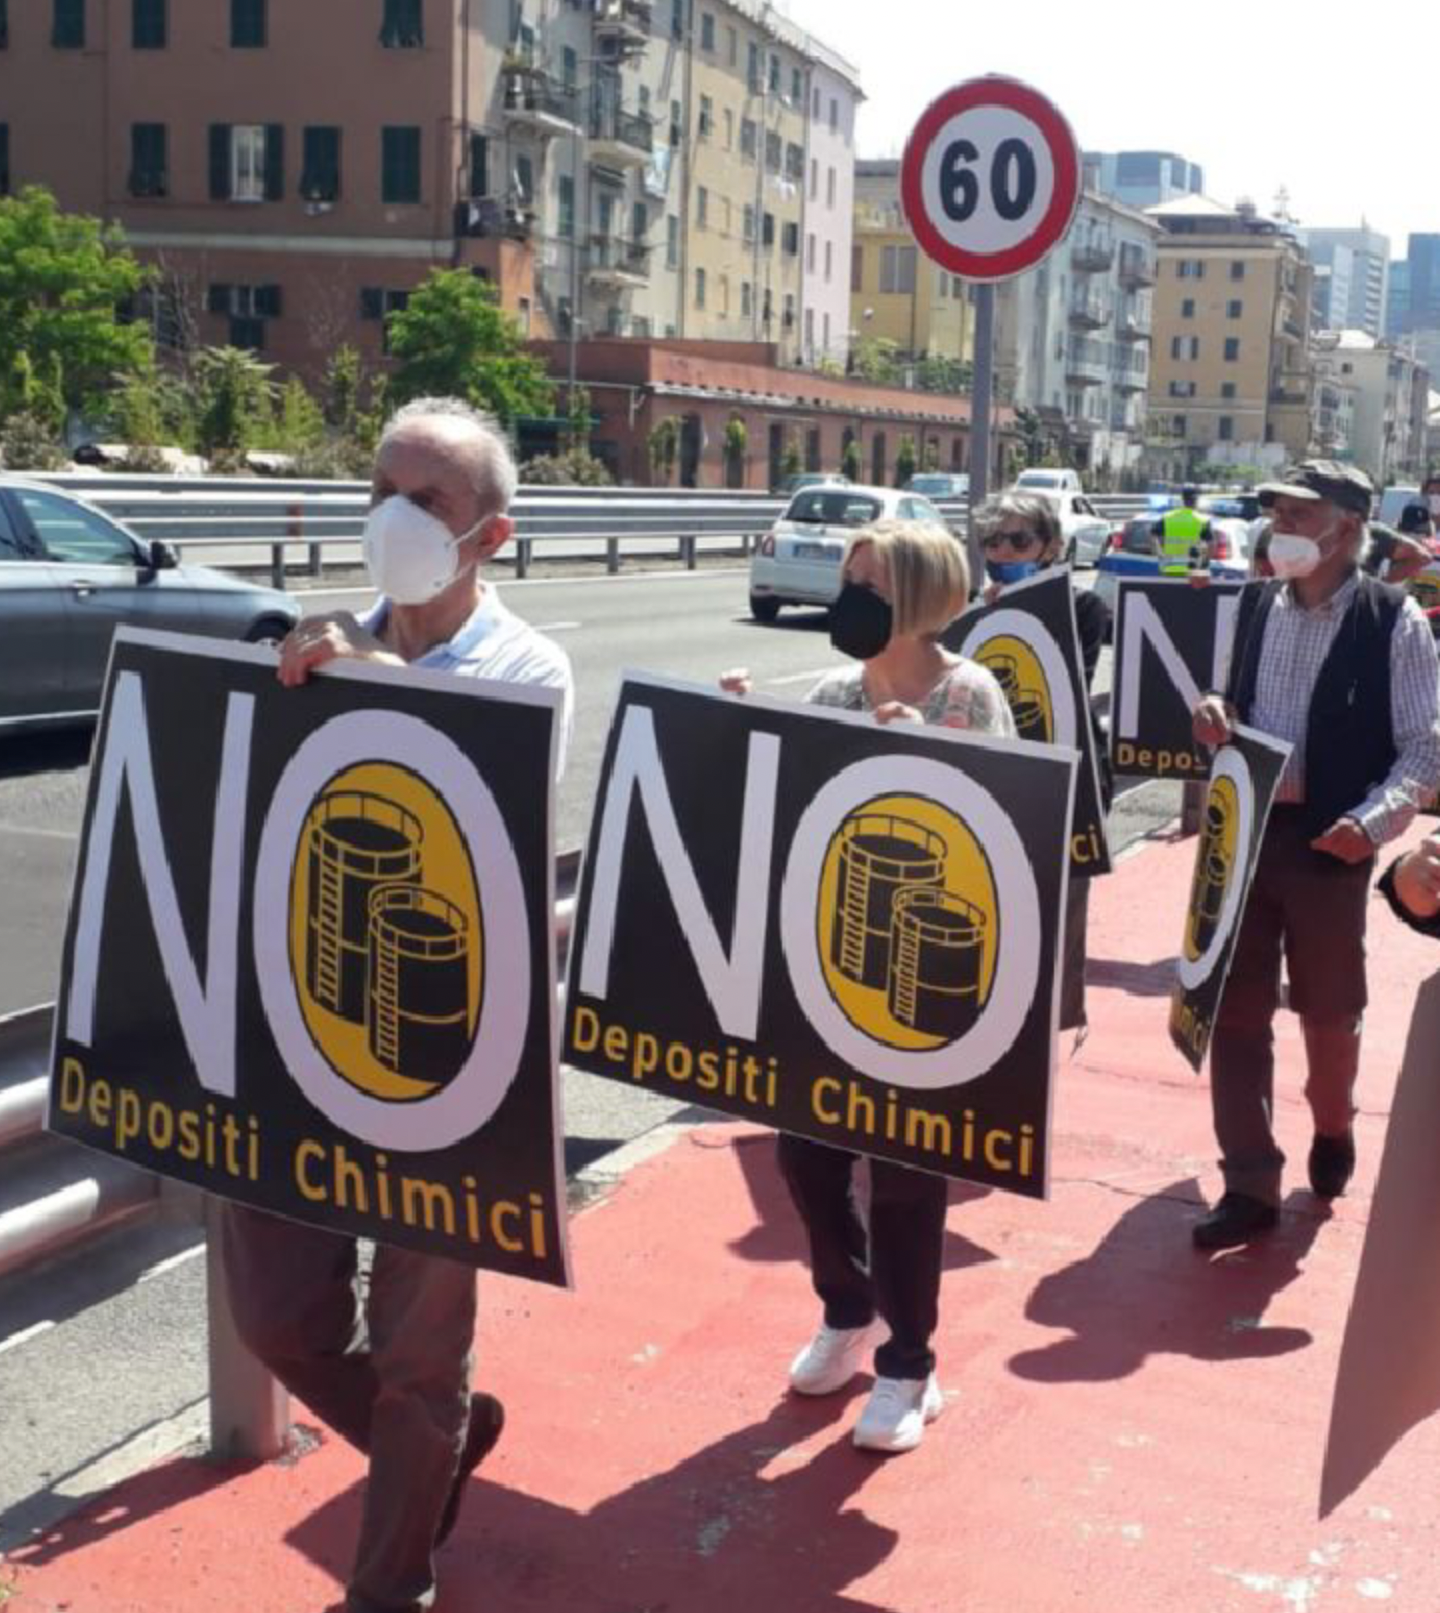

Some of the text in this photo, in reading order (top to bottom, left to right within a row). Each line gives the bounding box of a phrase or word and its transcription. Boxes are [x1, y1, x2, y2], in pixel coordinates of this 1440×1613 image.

[939, 137, 1037, 223] 60
[65, 669, 531, 1152] NO
[578, 704, 1042, 1090] NO
[59, 1057, 547, 1258] Depositi Chimici
[572, 1006, 1034, 1177] Depositi Chimici
